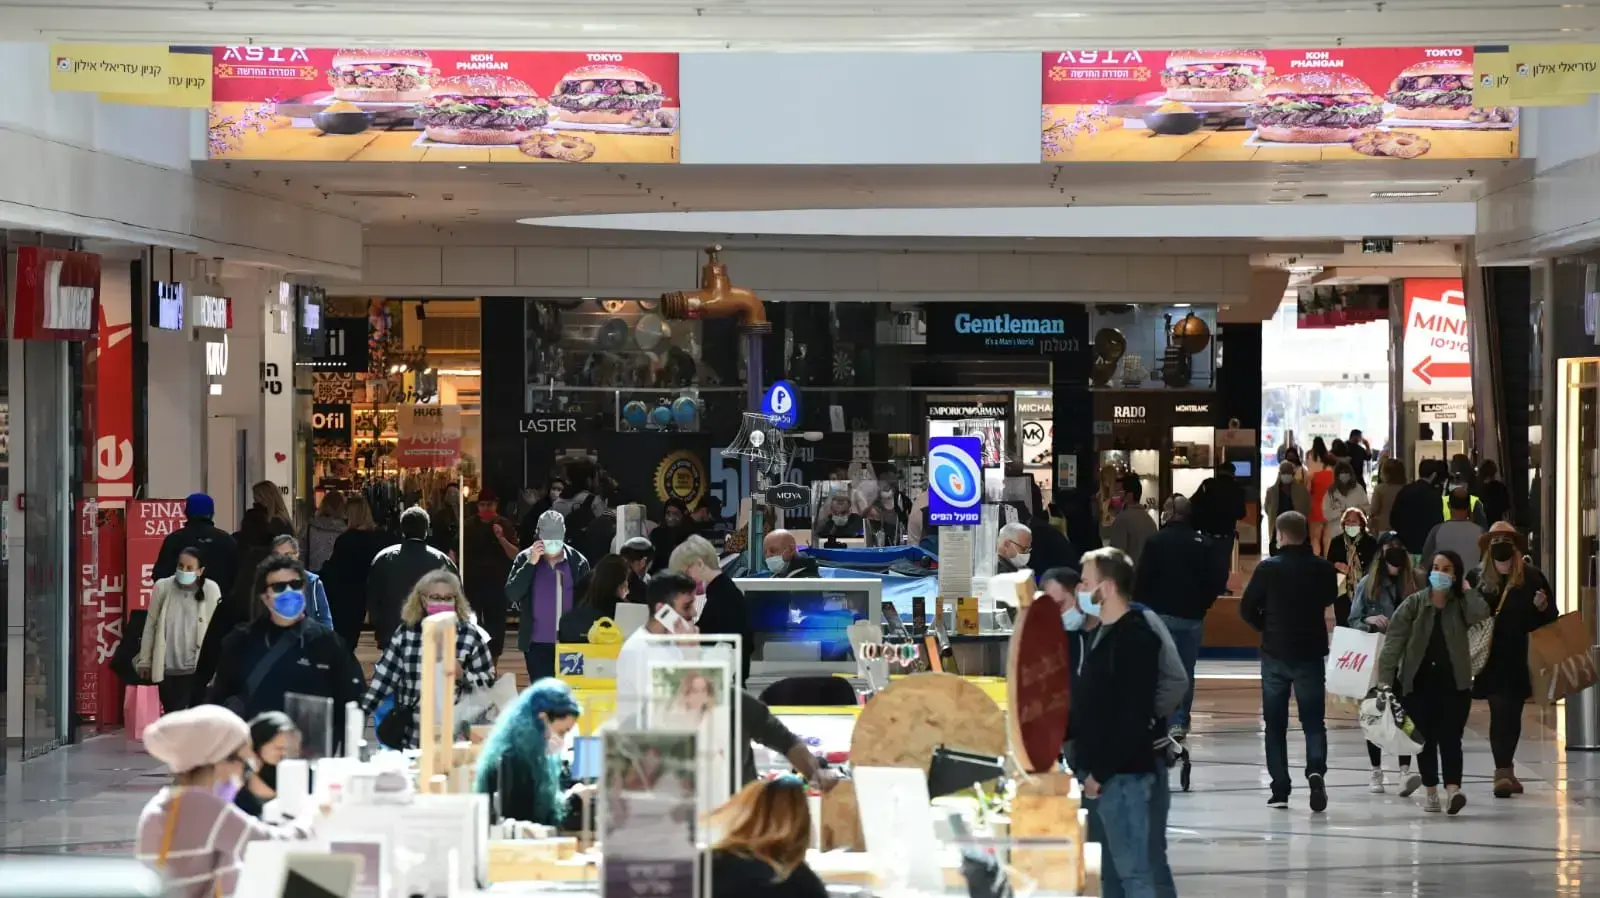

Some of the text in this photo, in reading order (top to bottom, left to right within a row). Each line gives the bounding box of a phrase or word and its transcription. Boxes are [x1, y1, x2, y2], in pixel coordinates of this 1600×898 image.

[223, 46, 310, 62] ASIA
[1057, 49, 1143, 64] ASIA
[1305, 52, 1329, 60] KOH
[1425, 48, 1463, 57] TOKYO
[470, 54, 494, 62] KOH
[586, 54, 623, 62] TOKYO
[74, 59, 162, 77] קניון עזריאלי אילון
[456, 62, 508, 70] PHANGAN
[1290, 60, 1344, 68] PHANGAN
[1532, 60, 1597, 76] עזריאלי אילון
[237, 67, 296, 77] הסדרה החדשה
[1070, 69, 1129, 79] הסדרה החדשה
[185, 77, 206, 89] קניון
[955, 313, 1065, 334] Gentleman
[929, 407, 1005, 416] EMPORIO ARMANI
[1114, 406, 1146, 418] RADO
[312, 413, 344, 429] Ofil
[520, 418, 577, 433] LASTER
[776, 491, 802, 500] MOYA
[140, 502, 187, 518] FINA
[930, 512, 979, 521] מפעל הפיס
